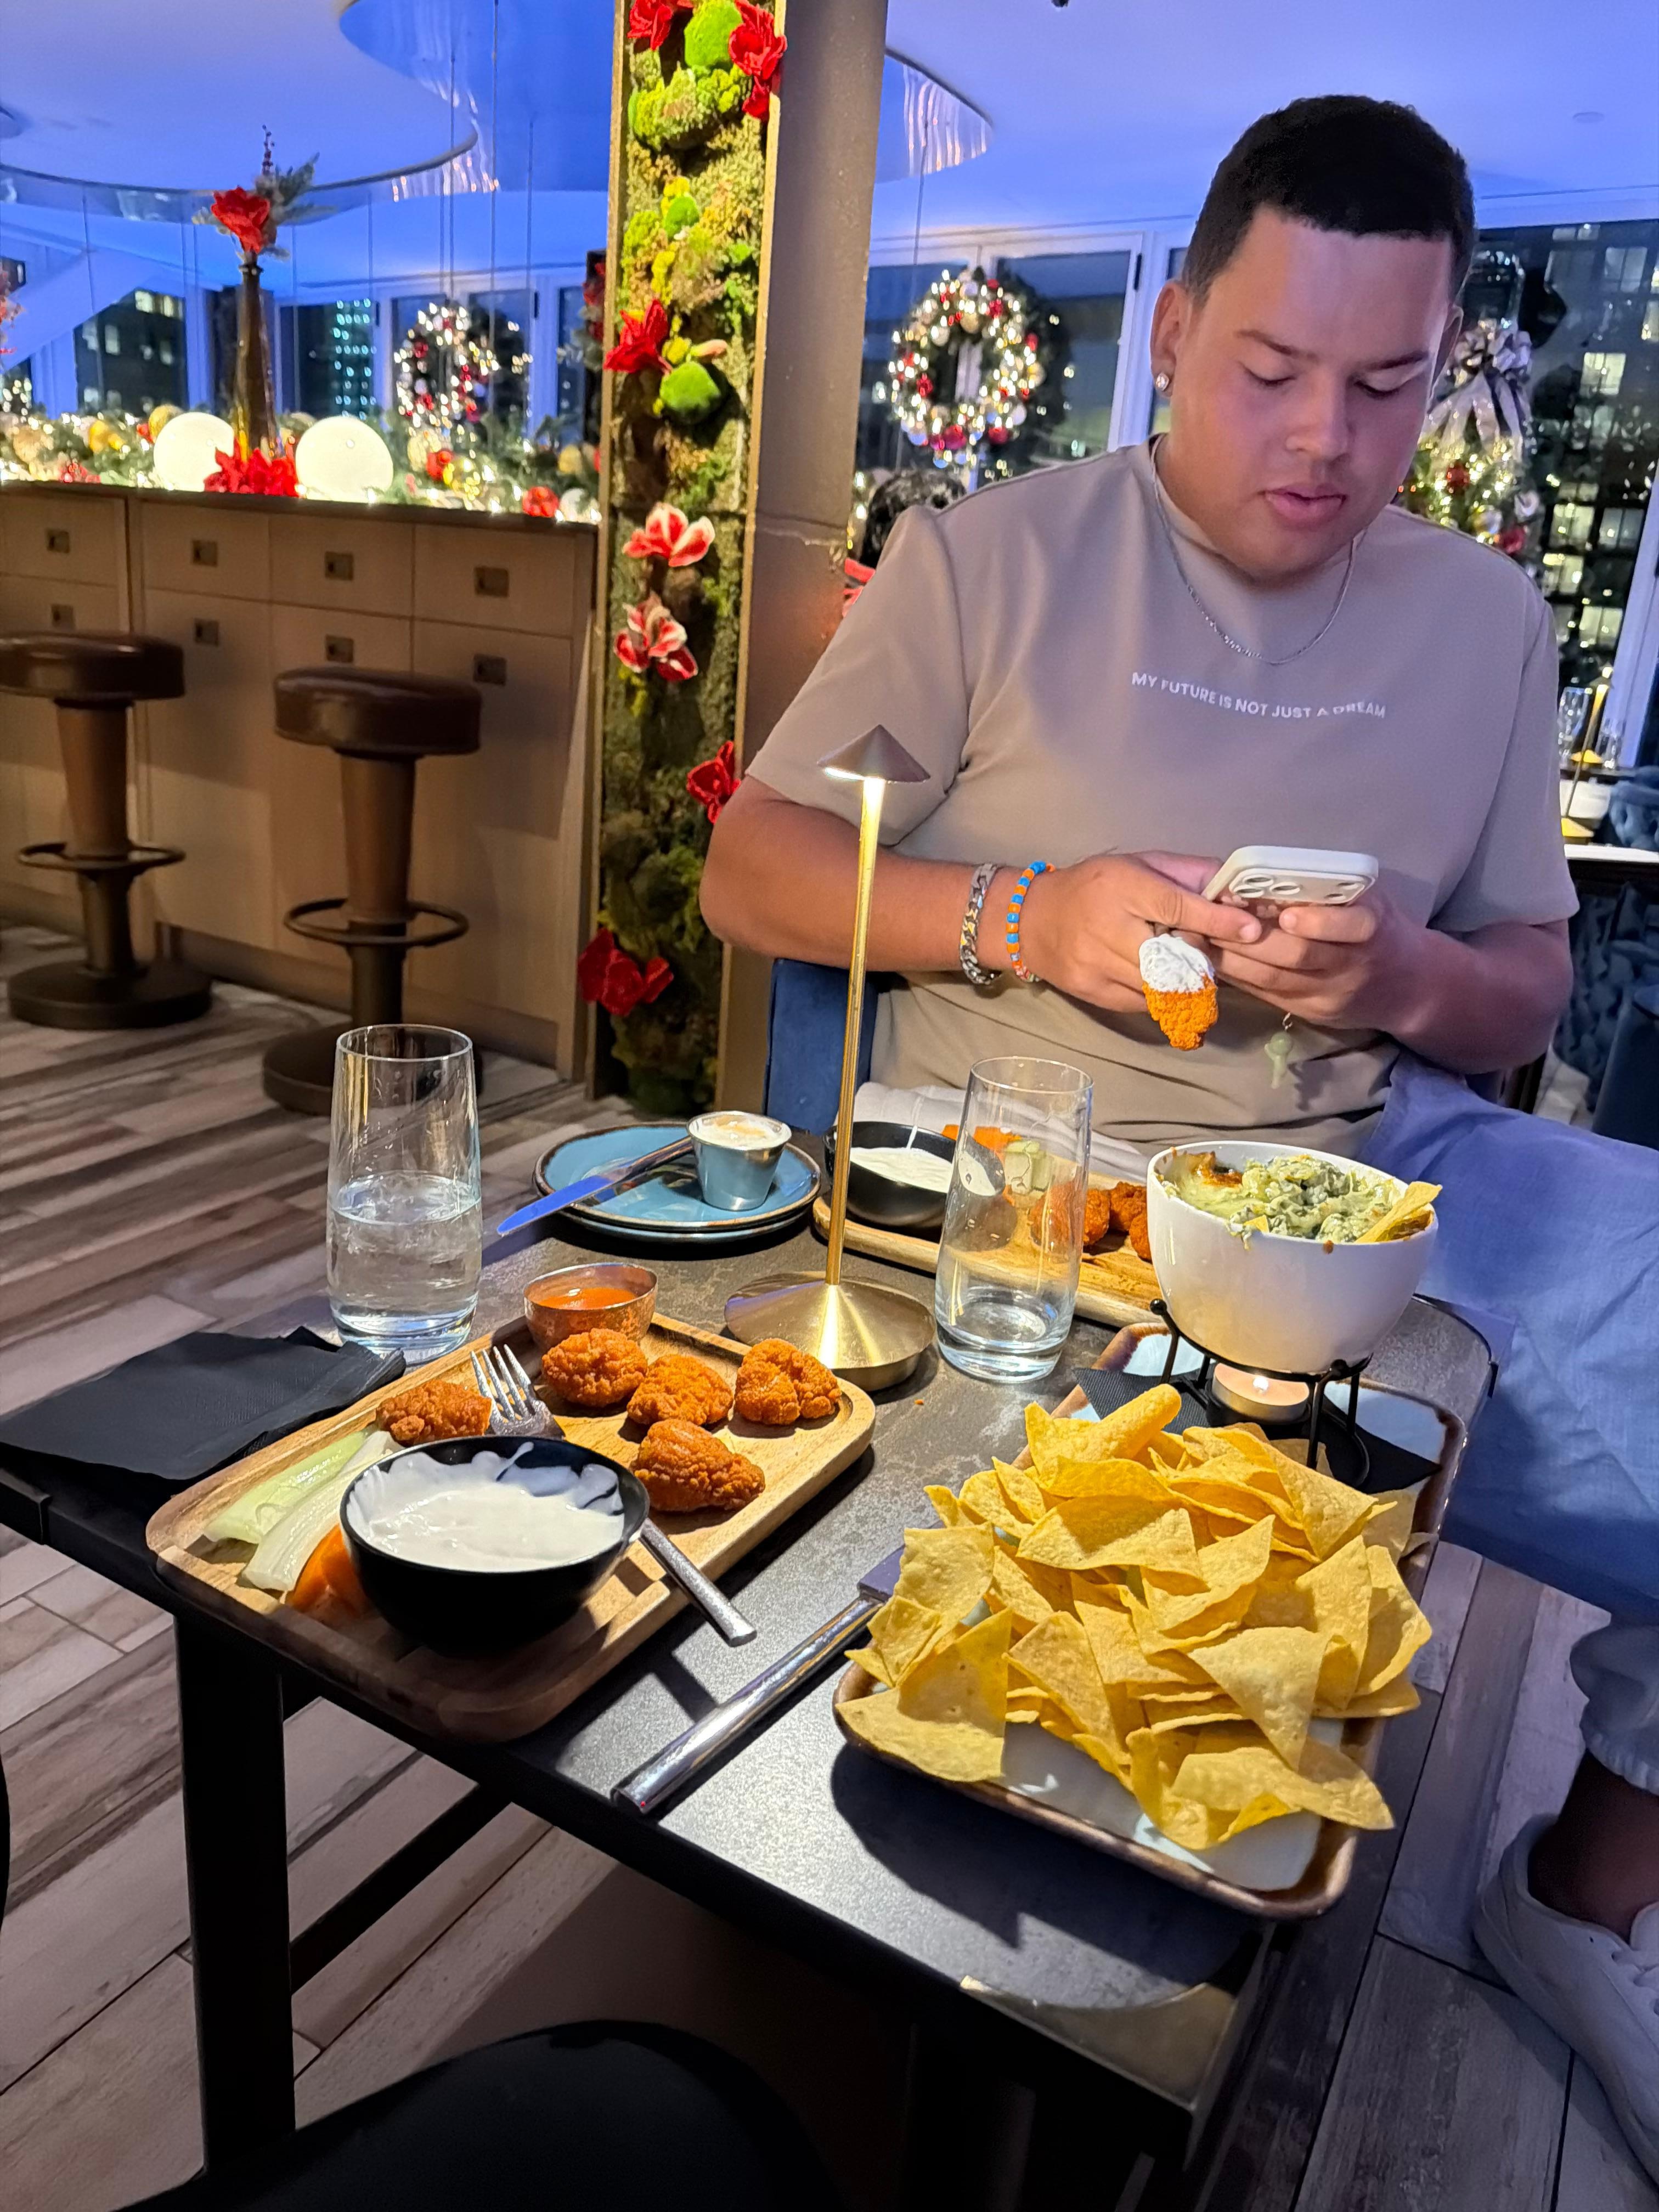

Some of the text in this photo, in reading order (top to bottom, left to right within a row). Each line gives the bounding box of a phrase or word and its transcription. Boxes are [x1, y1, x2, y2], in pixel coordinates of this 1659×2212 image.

[1132, 672, 1386, 719] MY FUTURE IS NOT JUST A DREAM
